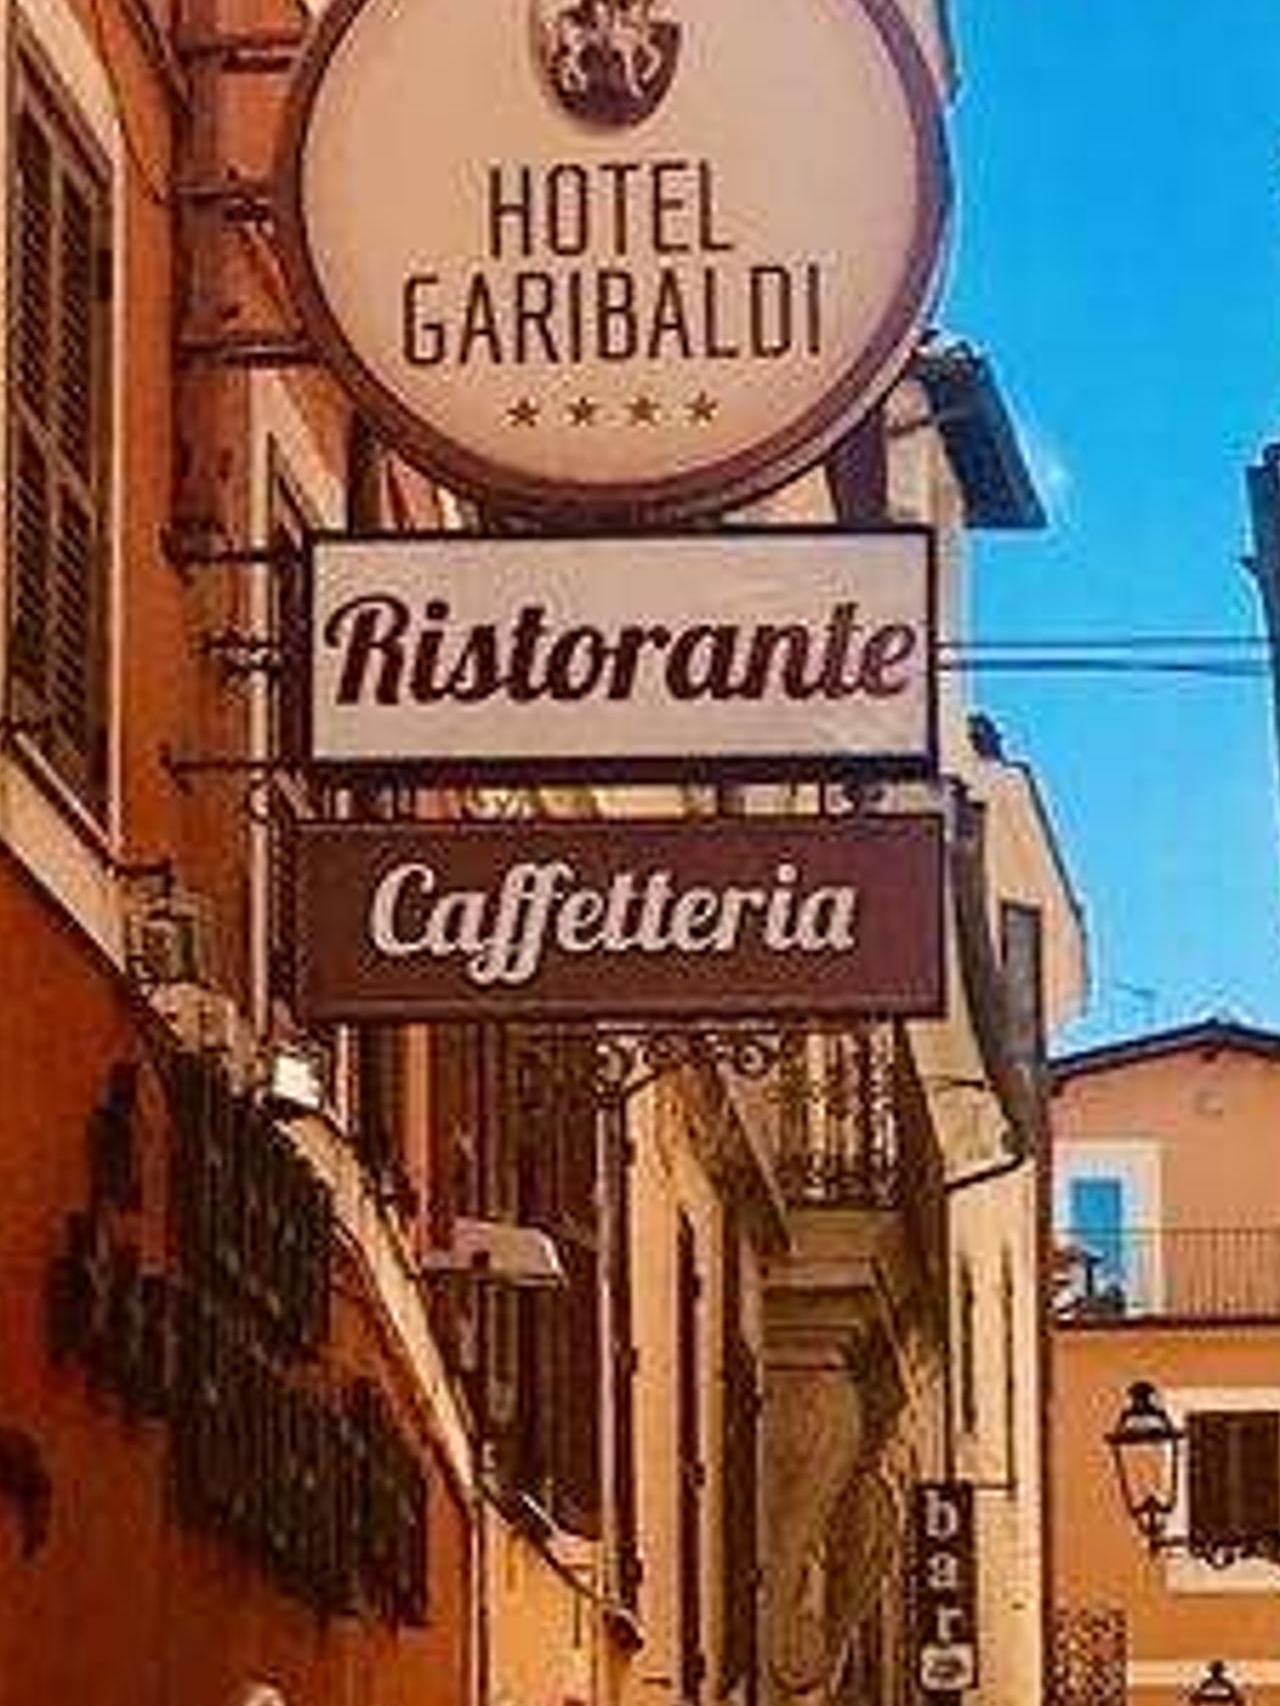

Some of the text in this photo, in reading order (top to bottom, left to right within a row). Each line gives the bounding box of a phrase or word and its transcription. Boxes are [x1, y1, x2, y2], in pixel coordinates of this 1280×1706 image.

[487, 160, 736, 257] HOTEL
[402, 263, 824, 366] GARIBALDI
[323, 593, 916, 707] Ristorante
[370, 862, 858, 984] Caffetteria
